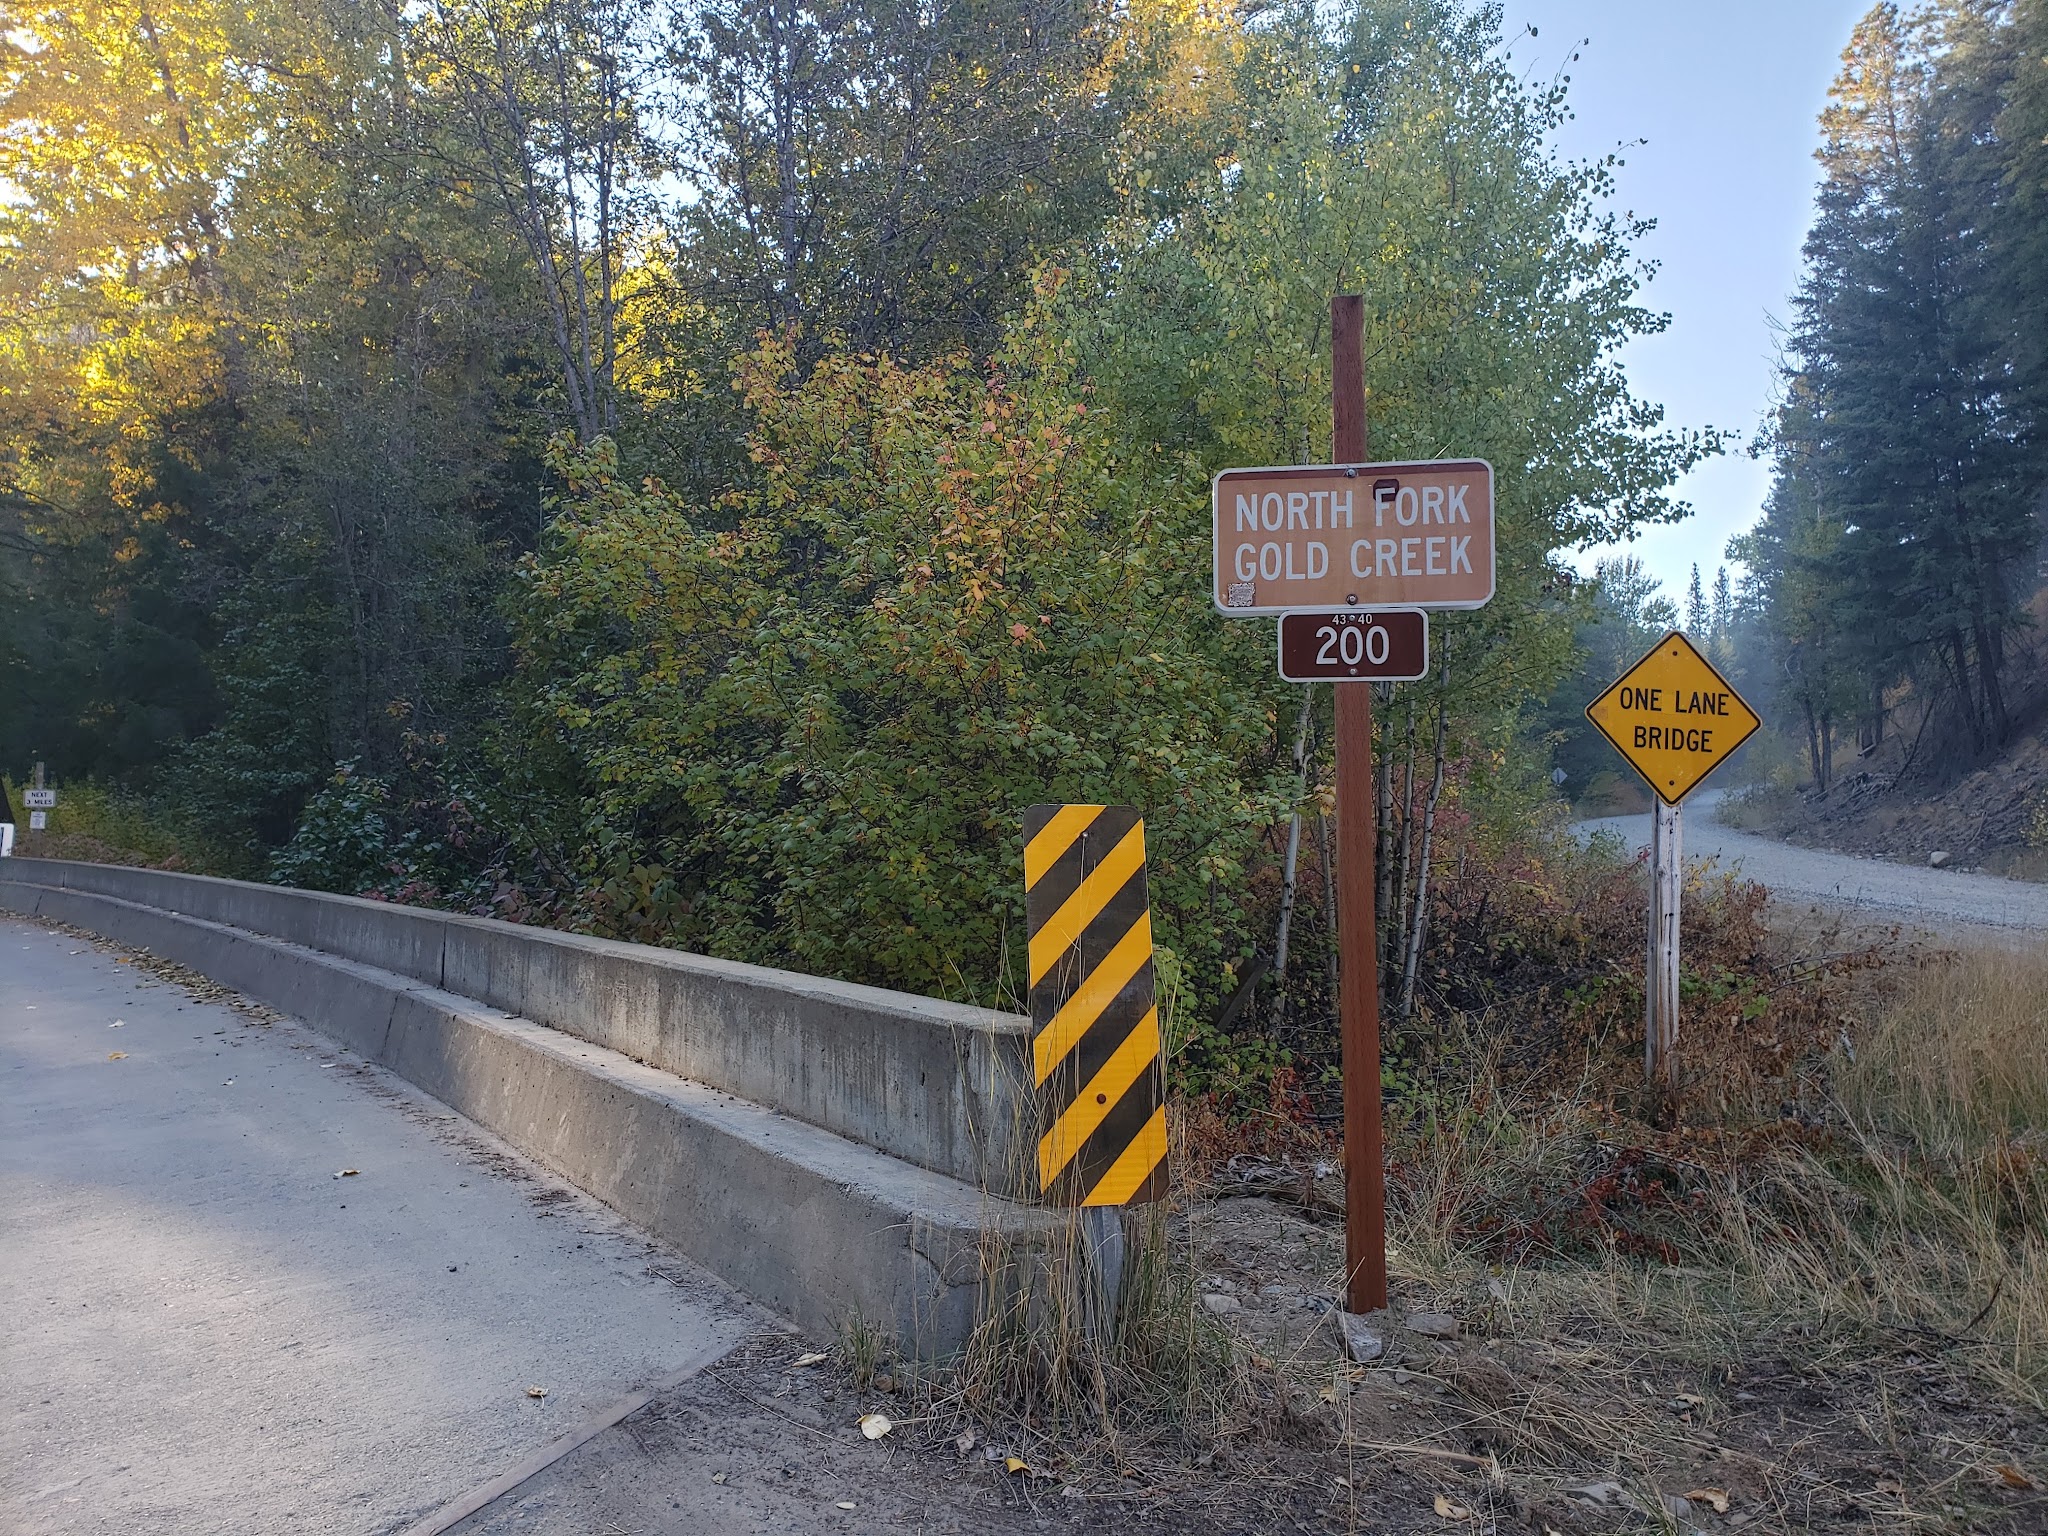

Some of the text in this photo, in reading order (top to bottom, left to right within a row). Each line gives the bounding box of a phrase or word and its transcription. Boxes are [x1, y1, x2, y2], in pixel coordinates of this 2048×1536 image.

[1236, 485, 1471, 532] NORTH FORK
[1235, 535, 1473, 582] GOLD CREEK
[1315, 625, 1390, 665] 200
[1620, 687, 1729, 716] ONE LANE
[1634, 725, 1713, 753] BRIDGE
